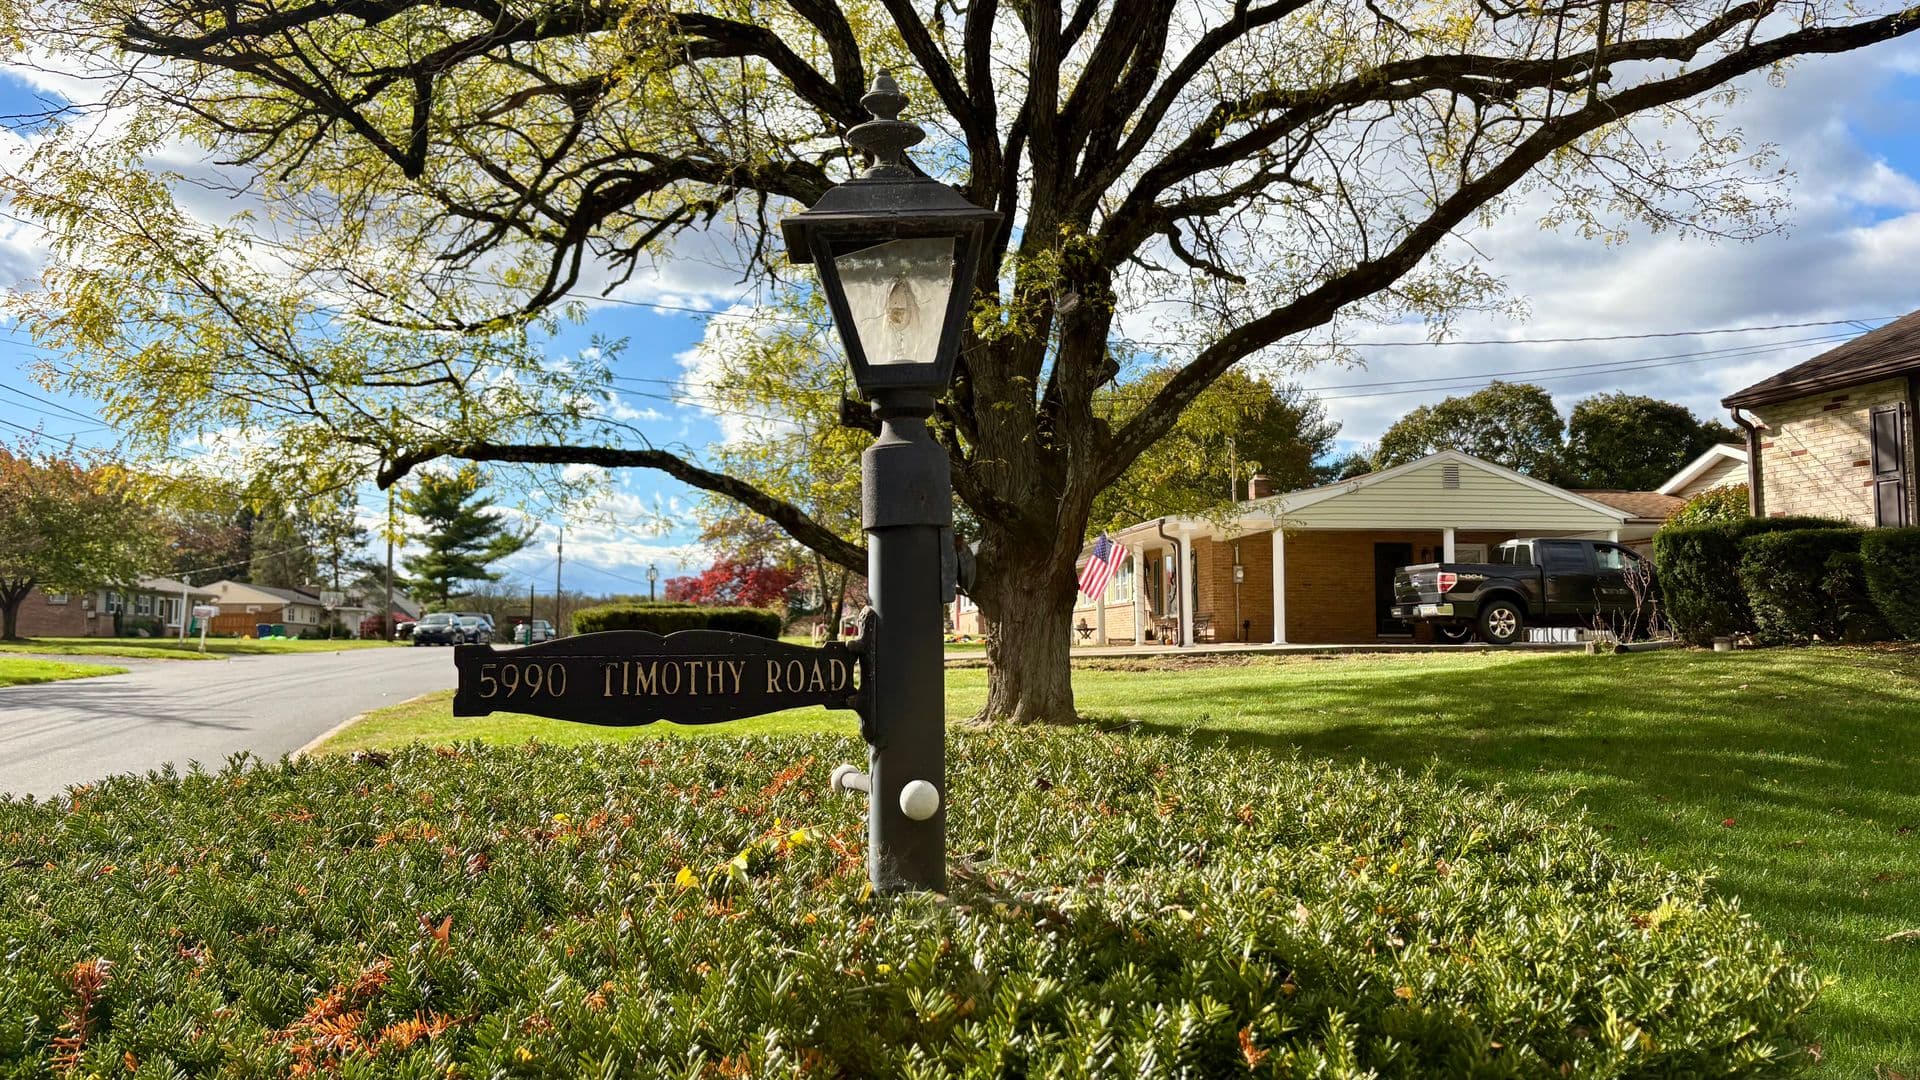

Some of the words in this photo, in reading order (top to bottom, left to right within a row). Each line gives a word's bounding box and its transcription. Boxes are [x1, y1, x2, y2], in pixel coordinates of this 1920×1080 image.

[479, 662, 567, 698] 5990
[600, 660, 746, 697] TIMOTHY
[766, 657, 847, 694] ROAD
